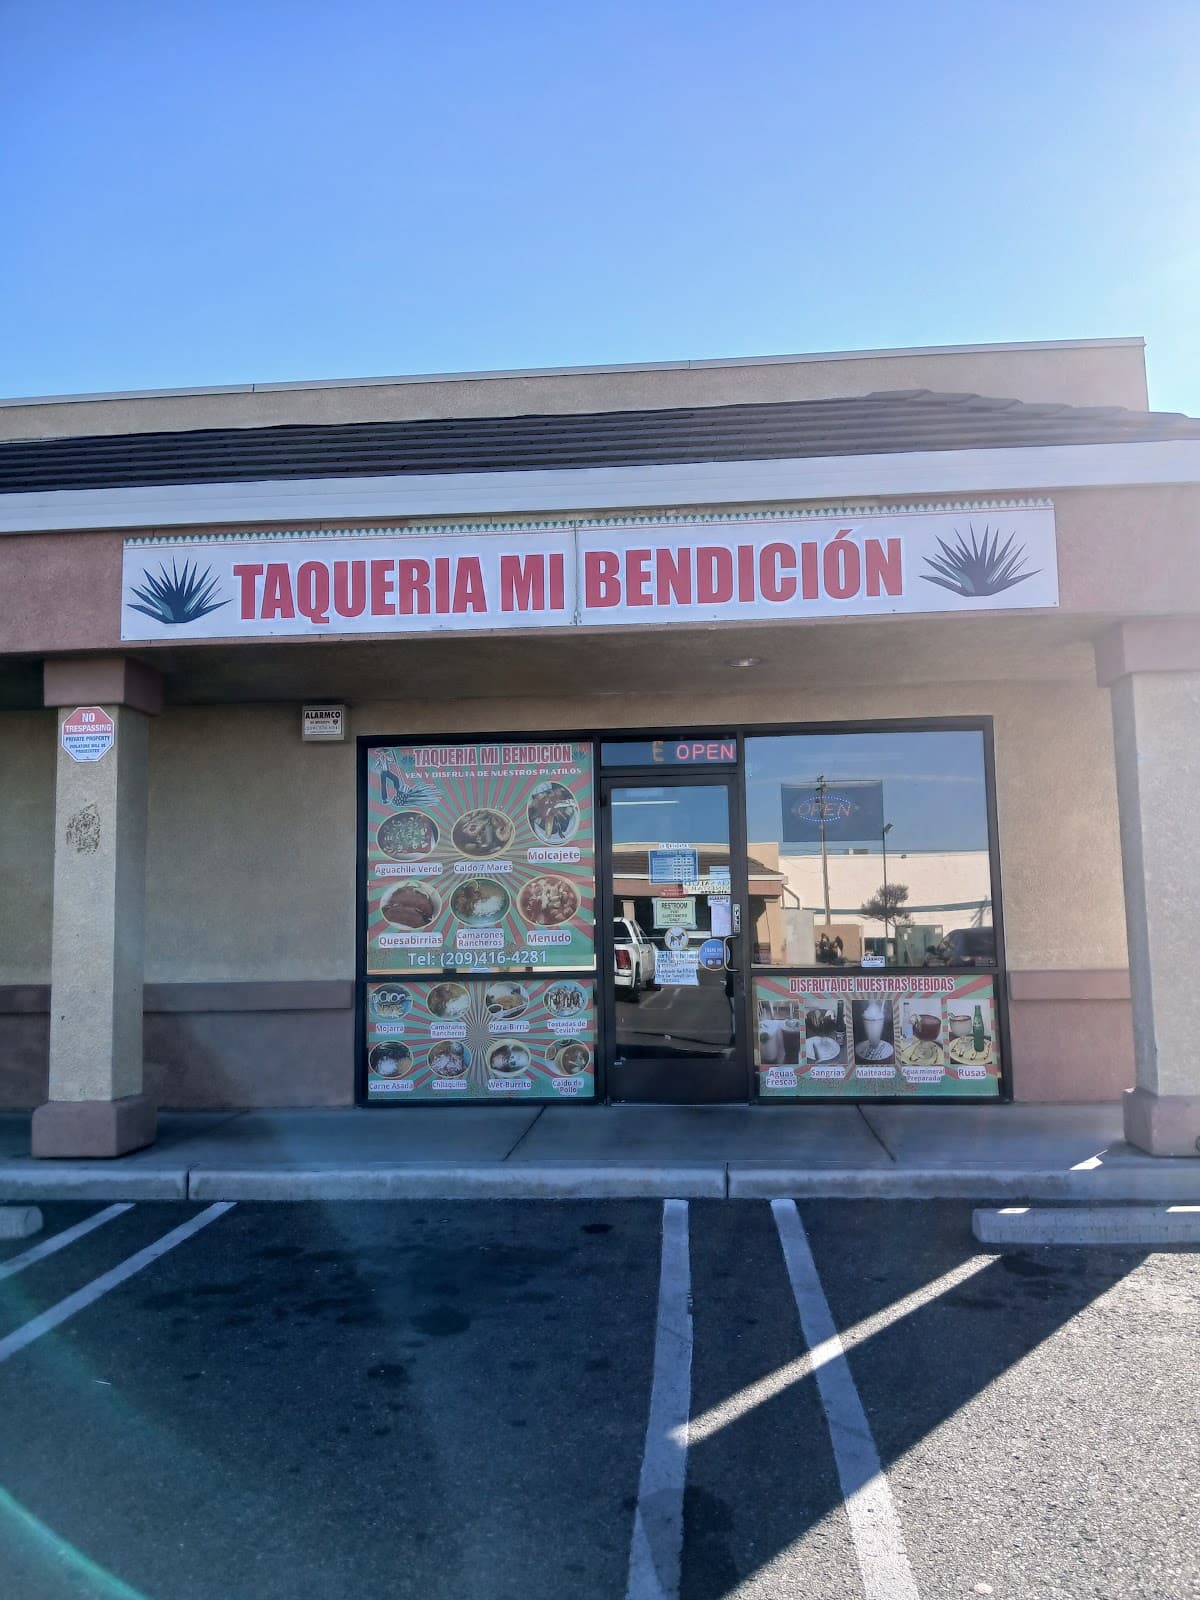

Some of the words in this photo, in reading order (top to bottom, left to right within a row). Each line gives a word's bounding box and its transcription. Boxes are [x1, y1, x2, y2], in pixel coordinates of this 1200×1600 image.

[234, 555, 485, 625] TAQUERIA
[500, 553, 565, 612] MI
[585, 530, 903, 608] BENDICIÓN
[81, 712, 96, 722] NO
[305, 711, 341, 719] ALARMCO
[65, 724, 112, 733] TRESPASSING
[676, 743, 734, 760] OPEN
[415, 748, 478, 767] TAQUERIA
[480, 747, 499, 765] MI
[432, 770, 475, 778] DISFRUTA
[490, 769, 537, 777] NUESTROS
[798, 802, 851, 816] OPEN
[528, 850, 580, 862] Molcajete
[376, 865, 417, 875] Aguachile
[418, 865, 442, 873] Verde
[454, 864, 478, 872] Caldo
[479, 864, 485, 872] 7
[487, 863, 512, 871] Mares
[457, 931, 504, 939] Camarones
[528, 933, 571, 943] Menudo
[379, 935, 442, 945] Quesabirrias
[458, 939, 502, 947] Rancheros
[408, 954, 435, 966] Tel:
[440, 951, 547, 967] (209)416-4281
[790, 978, 838, 992] DISFRUTA
[840, 978, 853, 992] DE
[856, 977, 908, 992] NUESTRAS
[910, 977, 955, 991] BEBIDAS
[376, 1024, 404, 1033] Mojarra
[489, 1023, 529, 1031] Pizza-Birria
[769, 1070, 794, 1079] Aguas
[856, 1069, 896, 1077] Malteadas
[903, 1068, 918, 1077] Agua
[958, 1069, 986, 1077] Rusas
[767, 1078, 798, 1086] Frescas
[907, 1075, 941, 1083] Preparada
[369, 1082, 390, 1090] Carne
[391, 1081, 413, 1089] Asada
[488, 1080, 531, 1089] Wet-Burrito
